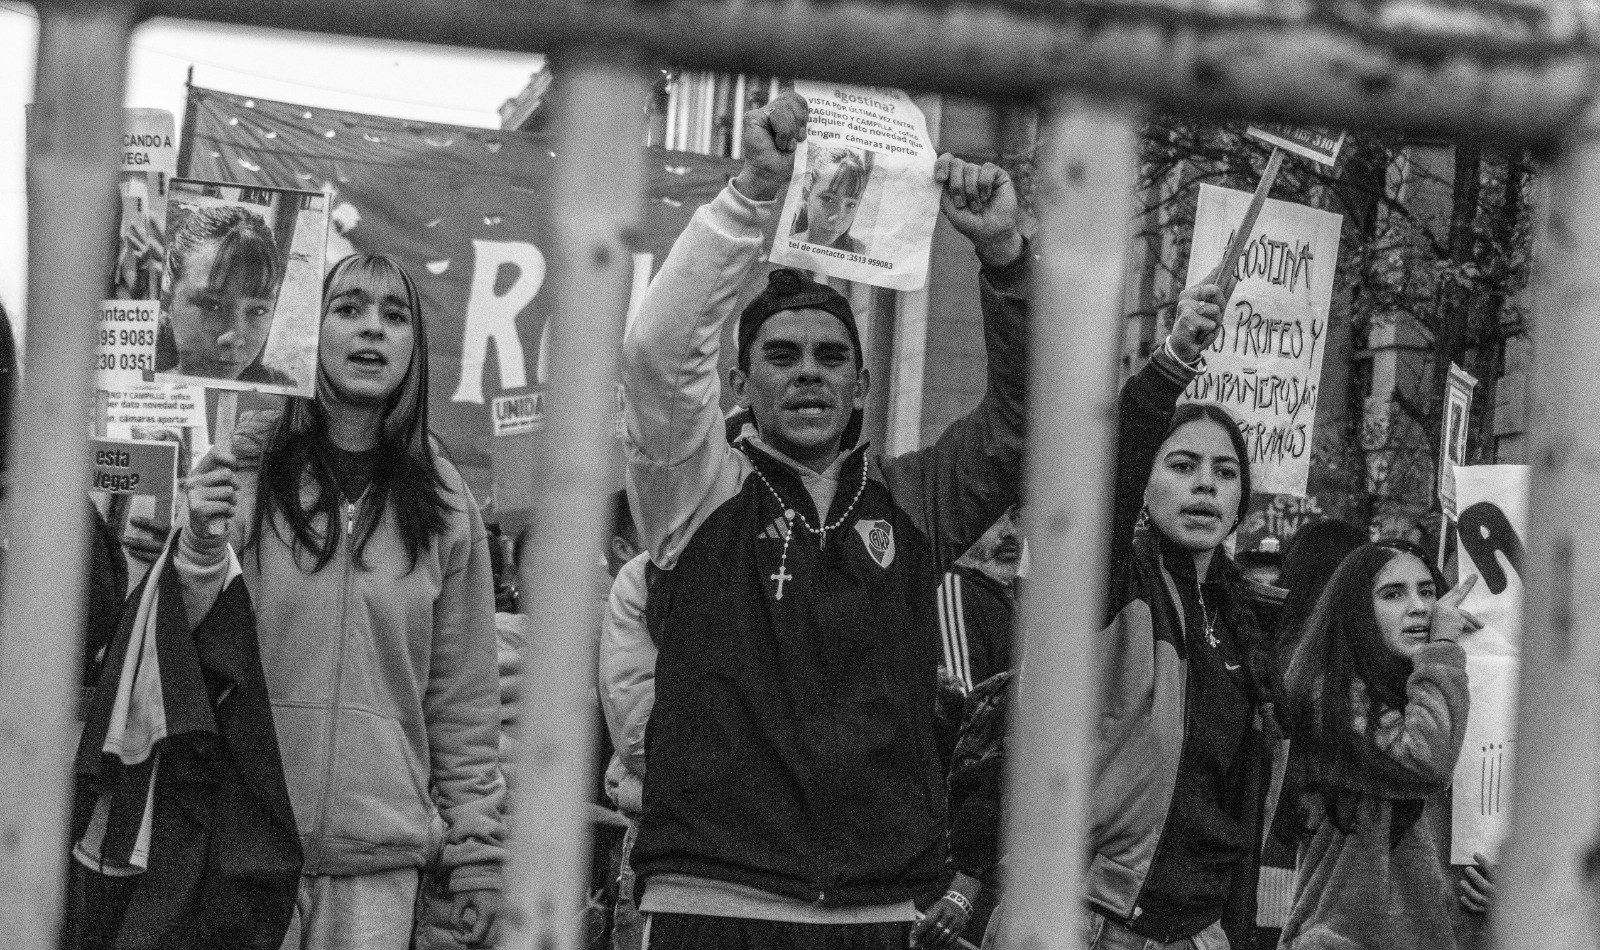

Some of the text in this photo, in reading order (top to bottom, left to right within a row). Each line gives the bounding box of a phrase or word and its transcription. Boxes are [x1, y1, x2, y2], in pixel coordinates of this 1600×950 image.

[808, 97, 830, 106] VISTA
[832, 102, 847, 111] POR
[833, 89, 895, 114] agostina?
[808, 107, 849, 121] RAGUIERO
[807, 115, 924, 149] ualquier dato novedad que
[121, 134, 172, 148] CANDO A
[845, 134, 883, 149] cámaras
[885, 143, 919, 157] aportar
[788, 240, 800, 249] tel
[801, 243, 811, 251] de
[812, 246, 845, 259] contacto
[867, 258, 893, 270] 959083
[98, 306, 155, 322] ontacto:
[120, 329, 154, 346] 9083
[120, 353, 153, 370] 0351
[96, 449, 130, 468] esta
